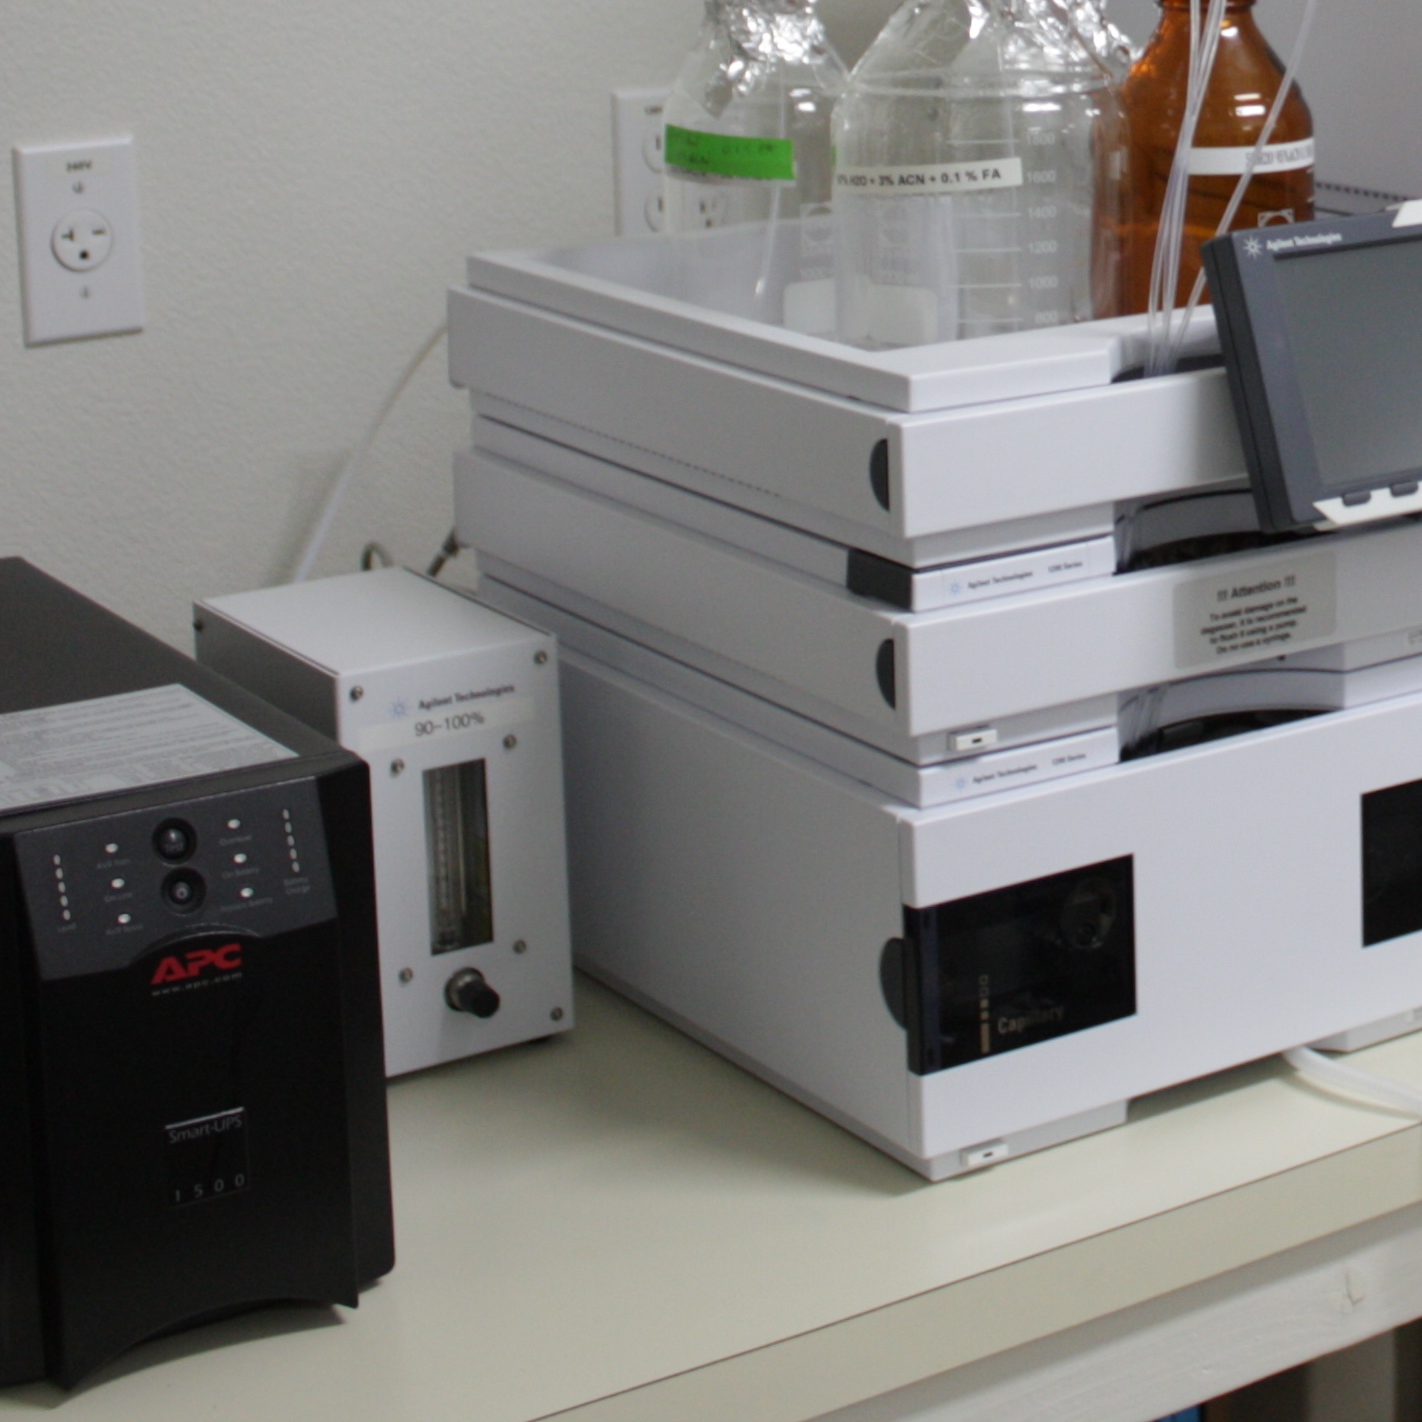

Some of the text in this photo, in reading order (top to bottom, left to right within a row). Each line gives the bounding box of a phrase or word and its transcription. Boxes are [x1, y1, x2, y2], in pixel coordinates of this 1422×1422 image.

[898, 173, 925, 186] ACN
[965, 171, 978, 182] %
[982, 168, 1002, 181] FA
[1266, 233, 1342, 252] Agilent Technologies
[1231, 579, 1282, 599] Attention
[419, 684, 515, 710] Agilent Technologies
[414, 711, 485, 737] 90-100%
[150, 943, 243, 985] APC
[168, 1114, 243, 1145] Smart-UPS
